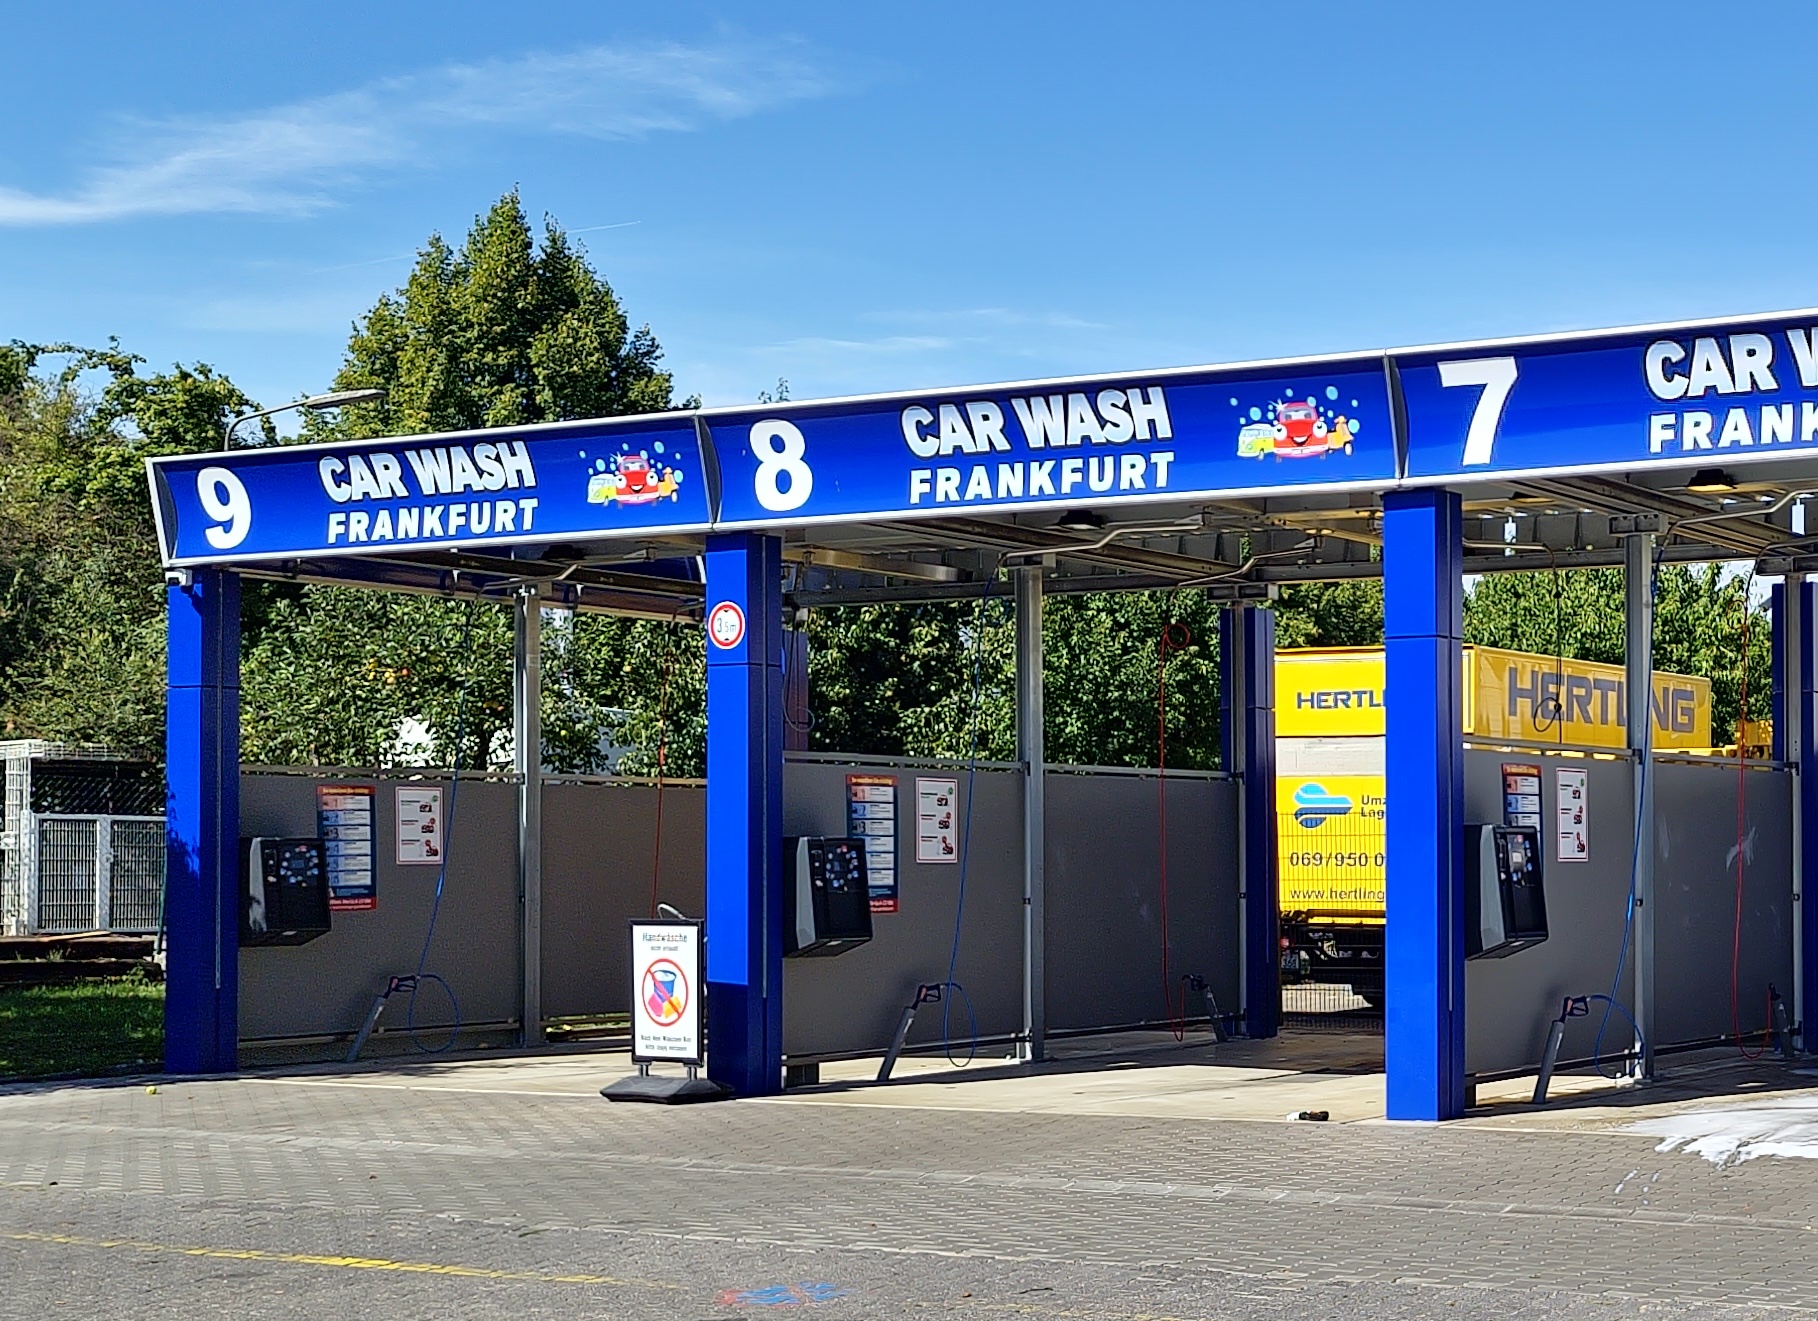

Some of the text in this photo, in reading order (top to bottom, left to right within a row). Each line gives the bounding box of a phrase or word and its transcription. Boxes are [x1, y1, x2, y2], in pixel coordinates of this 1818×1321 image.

[1643, 331, 1780, 400] CAR
[900, 385, 1174, 458] CAR WASH
[1436, 355, 1519, 467] 7
[318, 439, 537, 503] CAR WASH
[748, 418, 814, 513] 8
[908, 451, 1176, 504] FRANKFURT
[196, 466, 253, 550] 9
[326, 498, 540, 544] FRANKFURT
[1508, 666, 1695, 734] HERTLNG
